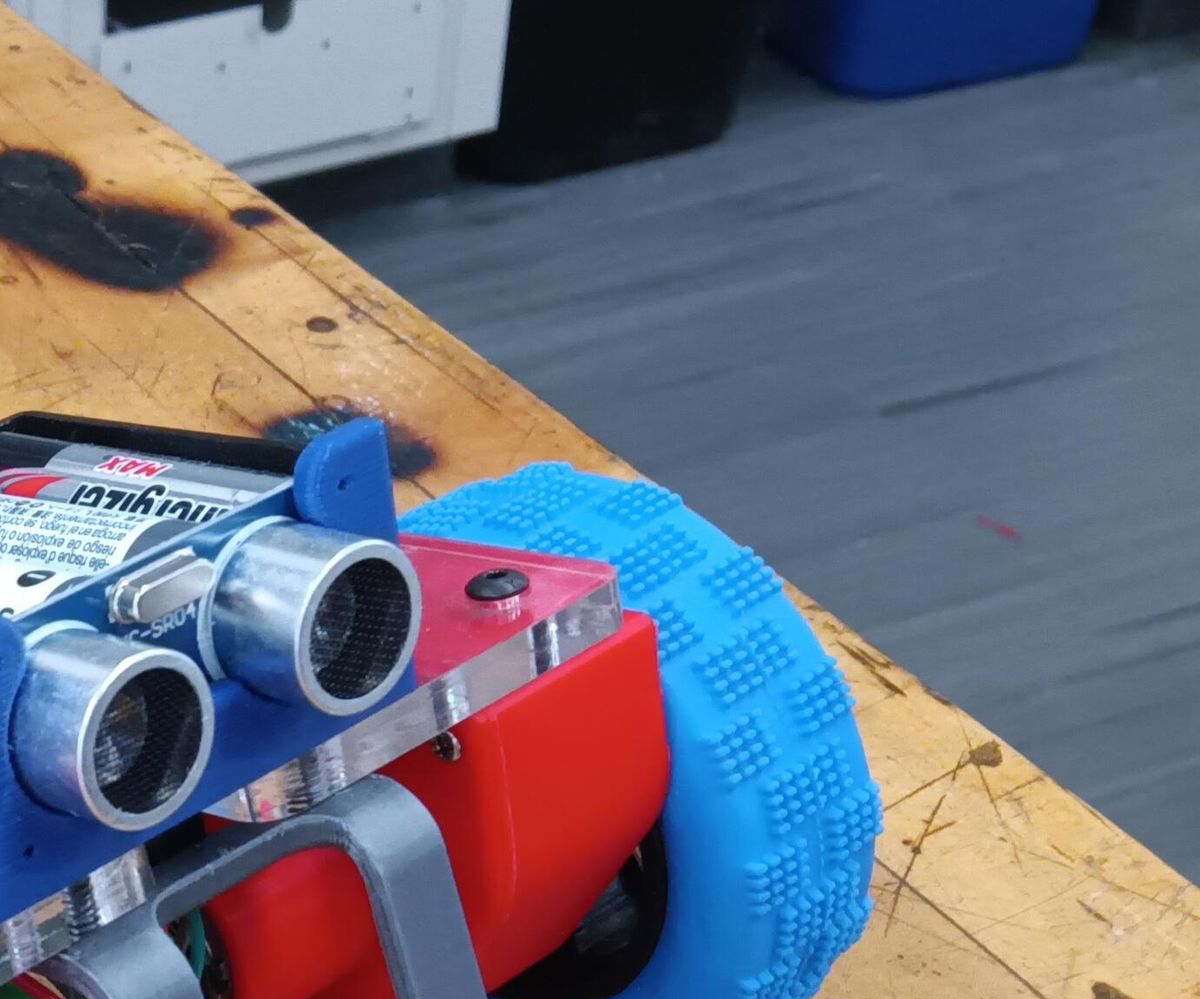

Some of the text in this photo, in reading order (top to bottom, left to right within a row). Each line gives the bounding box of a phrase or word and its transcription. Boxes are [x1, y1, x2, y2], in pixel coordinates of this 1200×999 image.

[97, 455, 169, 477] MAX
[71, 485, 225, 522] nergizer
[66, 538, 82, 550] de
[83, 540, 116, 555] riesgo
[128, 603, 197, 642] C-SR04
